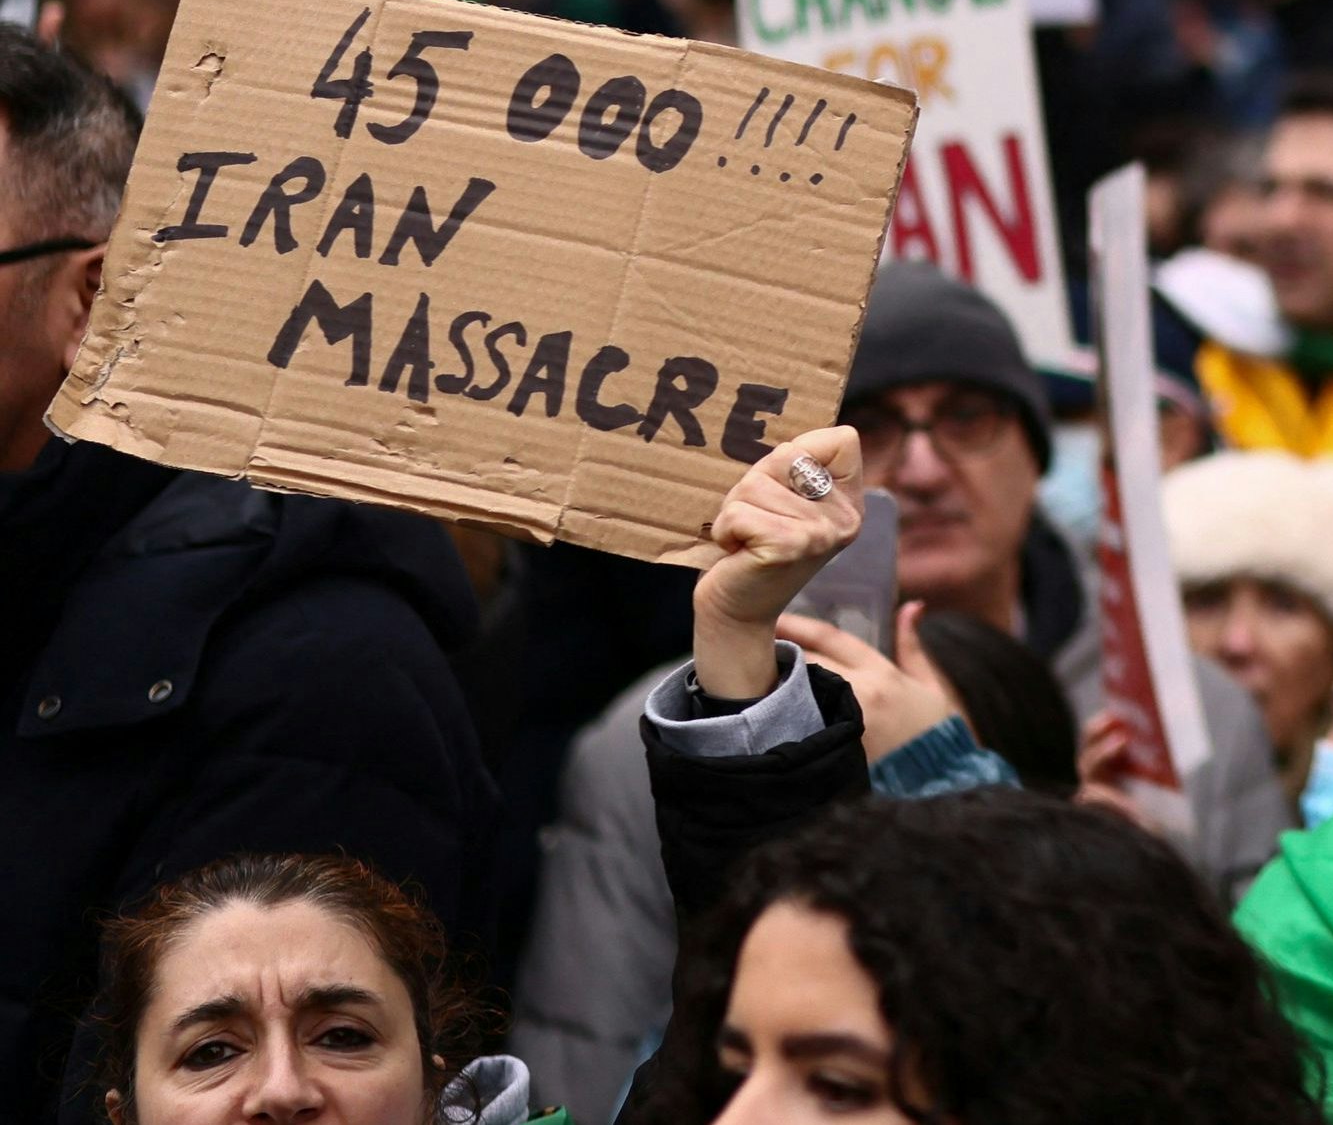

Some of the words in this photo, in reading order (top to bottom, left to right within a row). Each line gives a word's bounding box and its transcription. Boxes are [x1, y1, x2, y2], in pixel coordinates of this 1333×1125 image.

[310, 6, 474, 145] 45
[820, 35, 954, 109] OR
[152, 150, 497, 267] IRAN
[891, 133, 1043, 285] AN
[266, 279, 790, 465] MASSACRE
